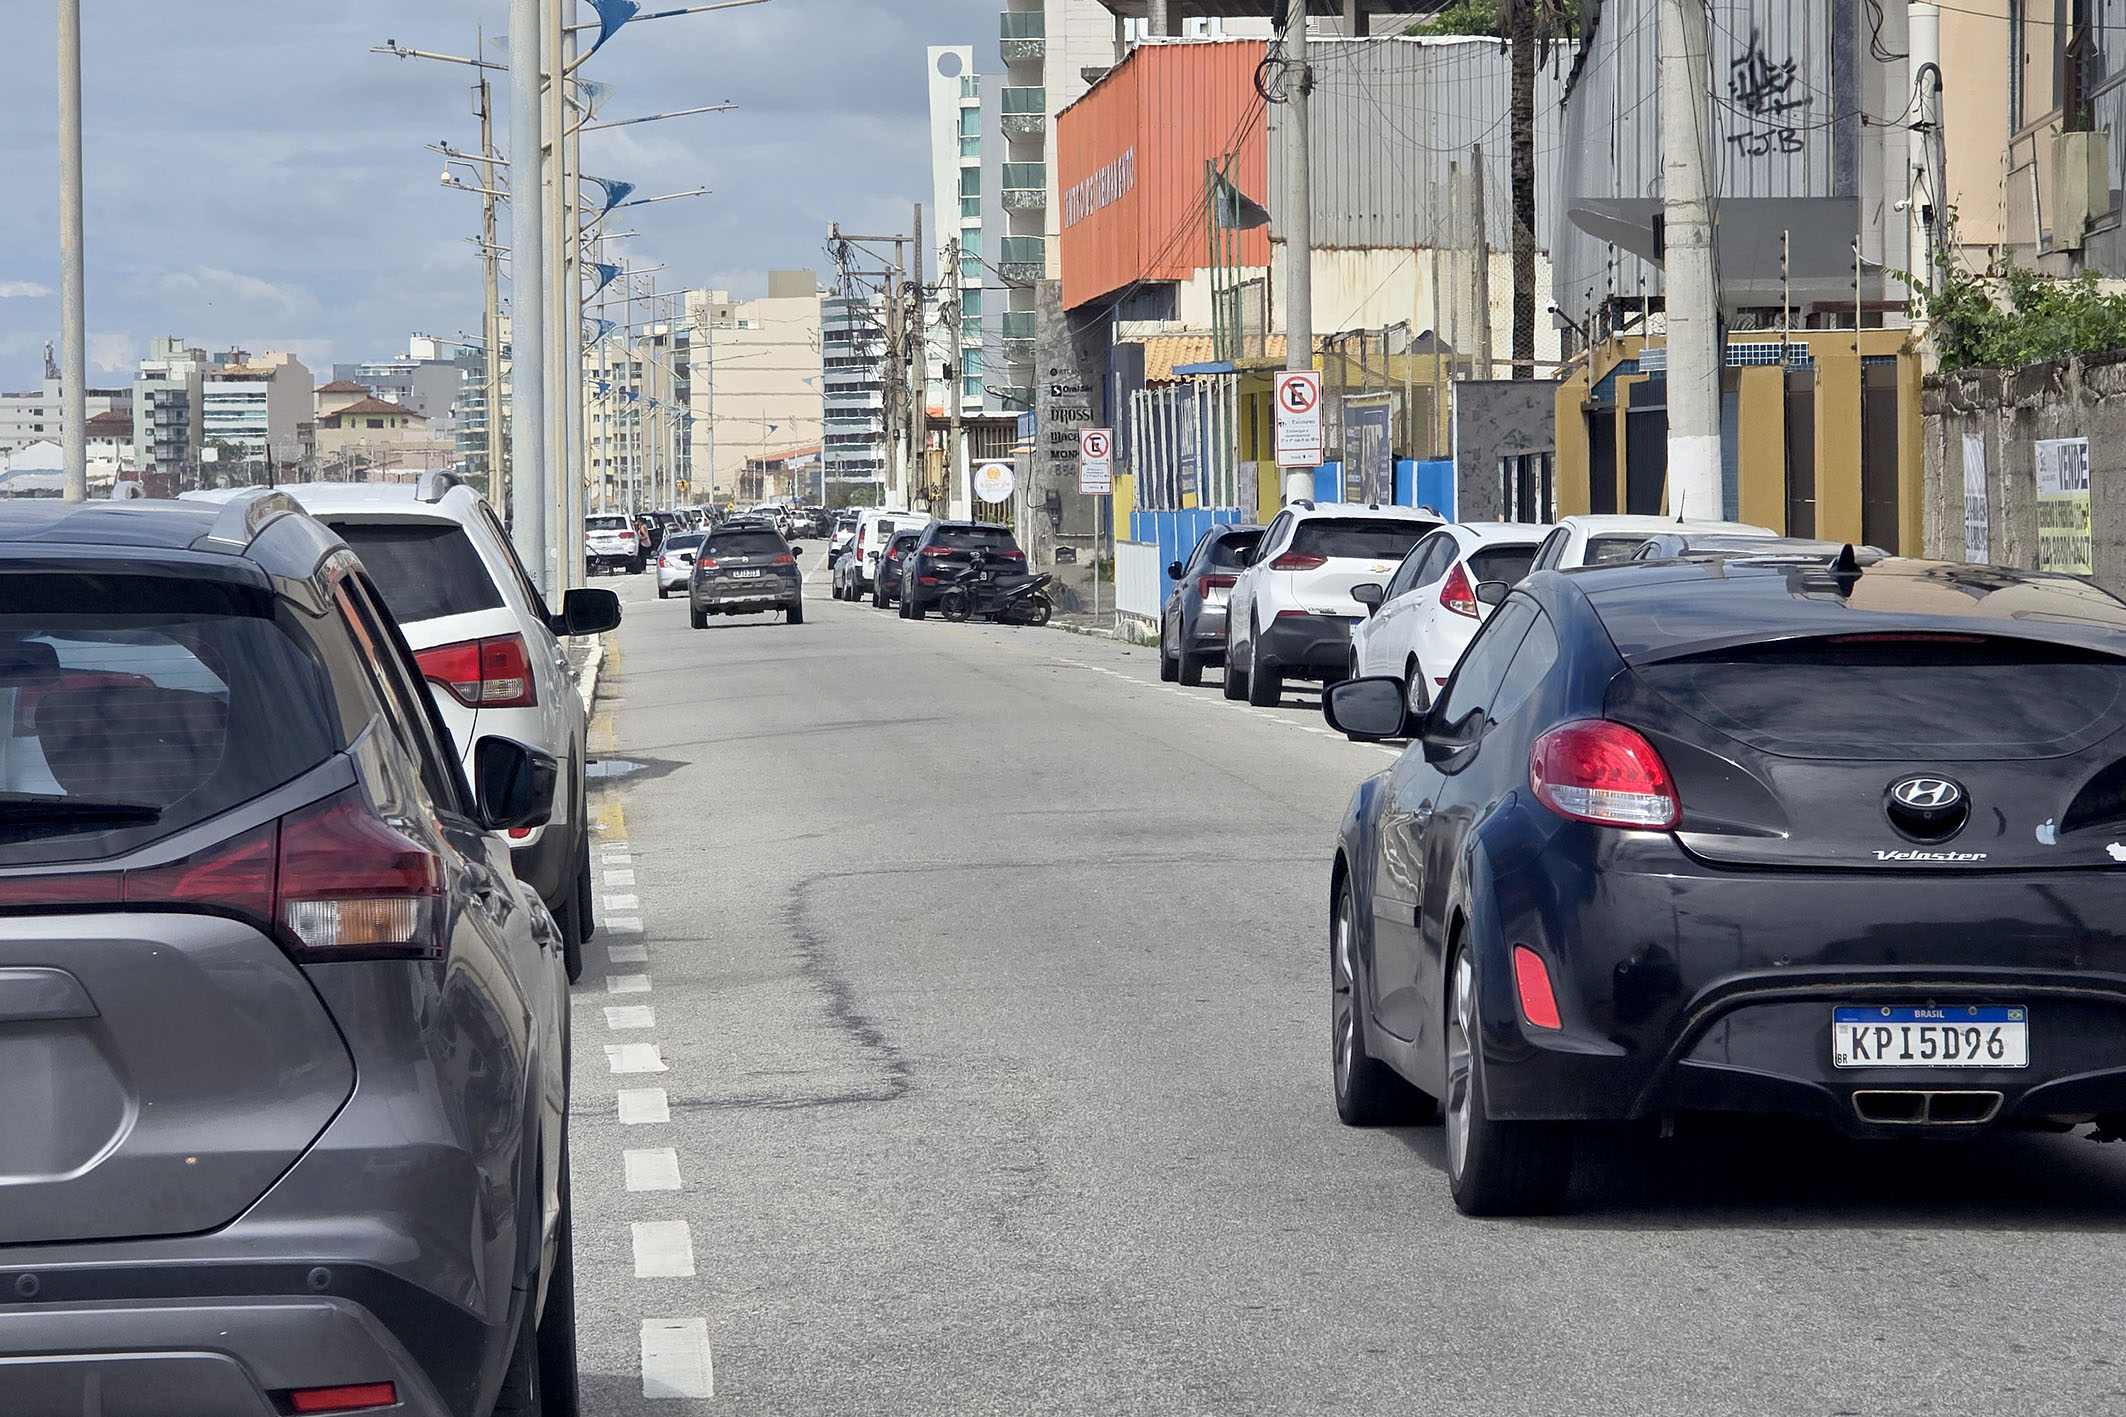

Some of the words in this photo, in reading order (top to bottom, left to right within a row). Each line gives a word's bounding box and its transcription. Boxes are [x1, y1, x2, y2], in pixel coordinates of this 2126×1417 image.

[2057, 444, 2089, 491] VENDE
[1872, 850, 1987, 862] Veloster
[1914, 1009, 1945, 1018] BRASIL
[1852, 1026, 2005, 1060] KPI5D96
[1837, 1053, 1848, 1064] BR
